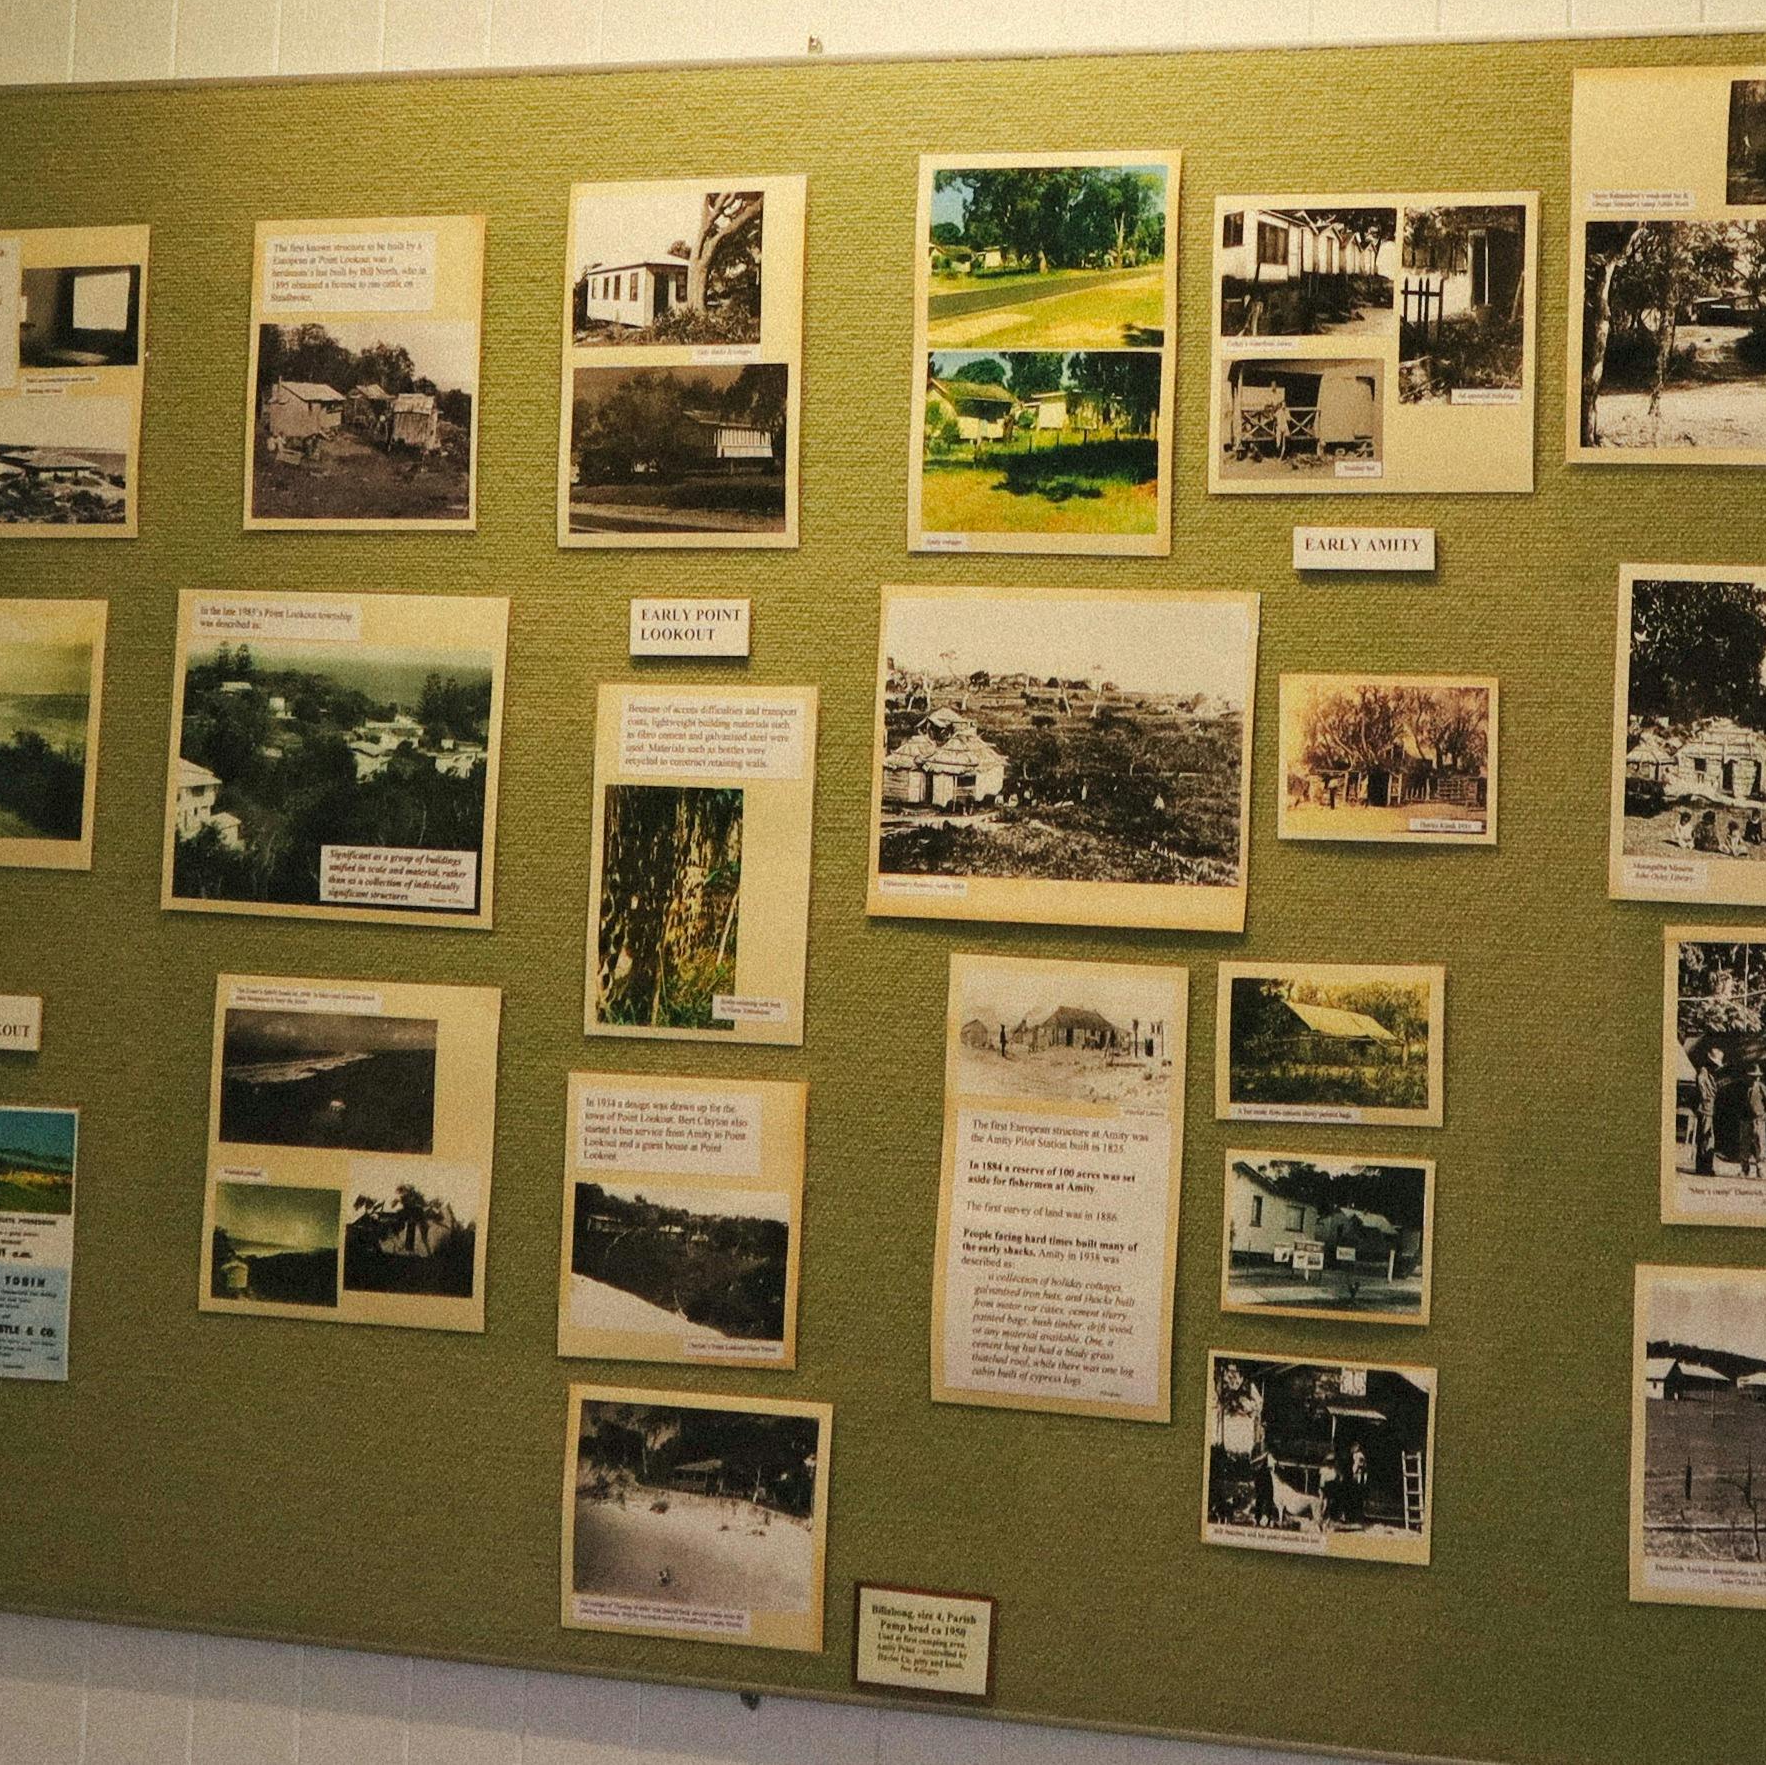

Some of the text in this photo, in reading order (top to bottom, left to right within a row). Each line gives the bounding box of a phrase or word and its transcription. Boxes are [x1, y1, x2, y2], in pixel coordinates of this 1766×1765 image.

[1306, 538, 1422, 552] EARLY AMITY
[642, 609, 740, 622] EARLY POINT
[641, 628, 714, 641] LOOKOUT
[586, 1098, 595, 1107] In
[624, 1100, 651, 1111] design
[669, 1102, 695, 1111] drawn
[709, 1103, 721, 1112] for
[722, 1103, 735, 1112] the
[973, 1120, 989, 1130] The
[990, 1121, 1008, 1131] first
[1009, 1122, 1051, 1136] European
[1052, 1125, 1089, 1137] structure
[1091, 1128, 1100, 1138] at
[1103, 1129, 1129, 1142] Amity
[971, 1133, 984, 1143] the
[987, 1134, 1012, 1147] Amity
[1015, 1136, 1036, 1147] Pilot
[1037, 1138, 1068, 1149] Station
[1069, 1140, 1090, 1151] built
[1091, 1142, 1100, 1151] in
[969, 1161, 980, 1170] In
[1011, 1167, 1045, 1175] reserve
[1046, 1166, 1057, 1176] of
[1076, 1171, 1101, 1179] acres
[1102, 1173, 1120, 1181] was
[1122, 1172, 1136, 1182] set
[969, 1174, 991, 1184] aside
[992, 1176, 1006, 1186] for
[1008, 1177, 1053, 1189] fishermen
[1055, 1180, 1065, 1190] at
[964, 1228, 1139, 1252] People facing hard times built many of
[963, 1241, 976, 1251] the
[978, 1243, 1001, 1255] early
[1040, 1248, 1064, 1261] Amity
[1103, 1256, 1120, 1264] was
[5, 1275, 45, 1287] TOBIN
